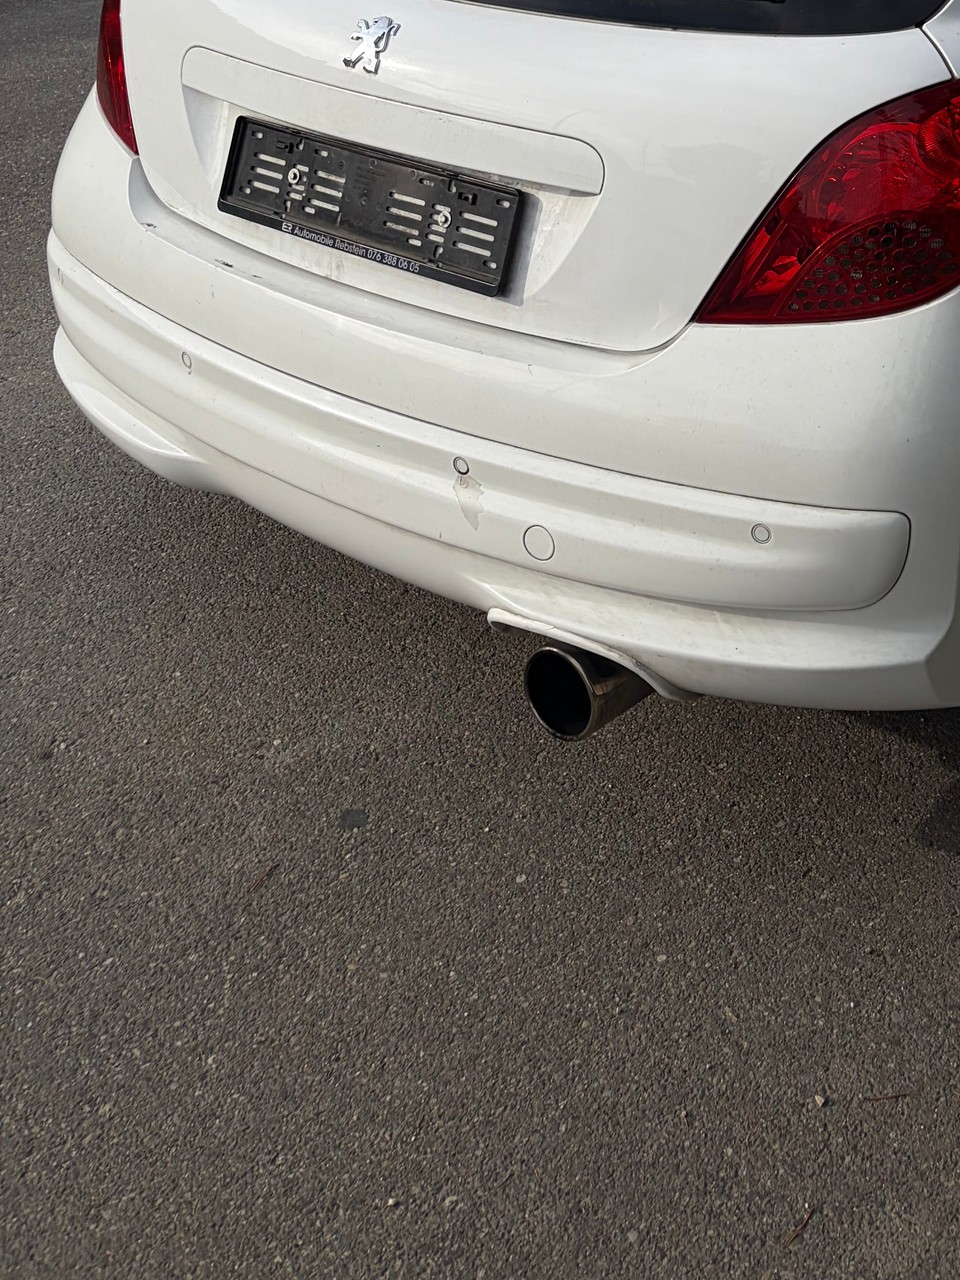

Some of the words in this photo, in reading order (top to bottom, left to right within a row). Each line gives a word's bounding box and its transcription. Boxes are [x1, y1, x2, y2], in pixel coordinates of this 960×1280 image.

[294, 226, 334, 247] Automobile
[335, 239, 366, 256] Rebstein
[367, 249, 382, 262] 076
[383, 253, 397, 266] 388
[398, 258, 408, 270] 06
[409, 261, 420, 273] 05
